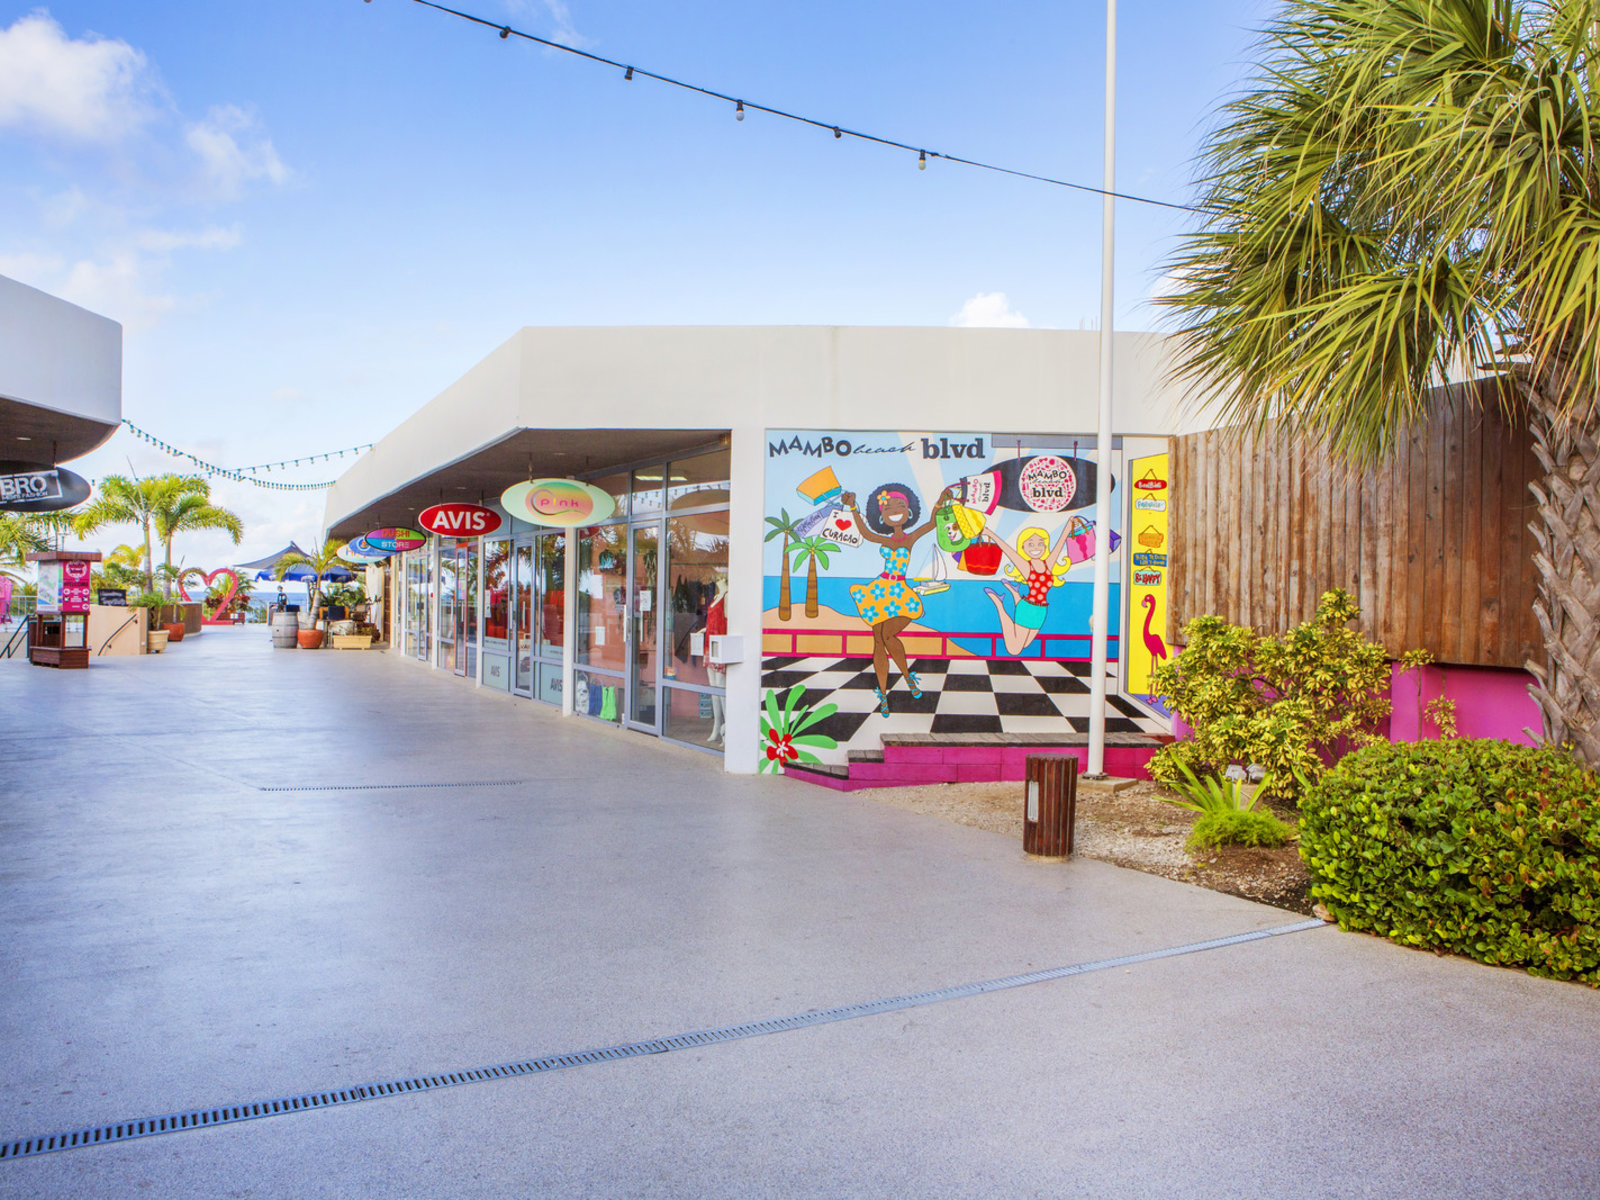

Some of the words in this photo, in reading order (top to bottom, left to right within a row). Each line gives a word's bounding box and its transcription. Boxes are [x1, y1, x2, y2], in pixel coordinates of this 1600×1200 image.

[769, 435, 851, 458] MAMBO
[853, 441, 916, 454] beach
[921, 437, 985, 460] blvd
[1028, 469, 1067, 480] MAMBO
[982, 482, 991, 502] blvd
[1032, 486, 1064, 498] blvd
[432, 510, 486, 530] AVIS
[382, 528, 410, 538] DUSHI
[381, 541, 410, 549] STORE
